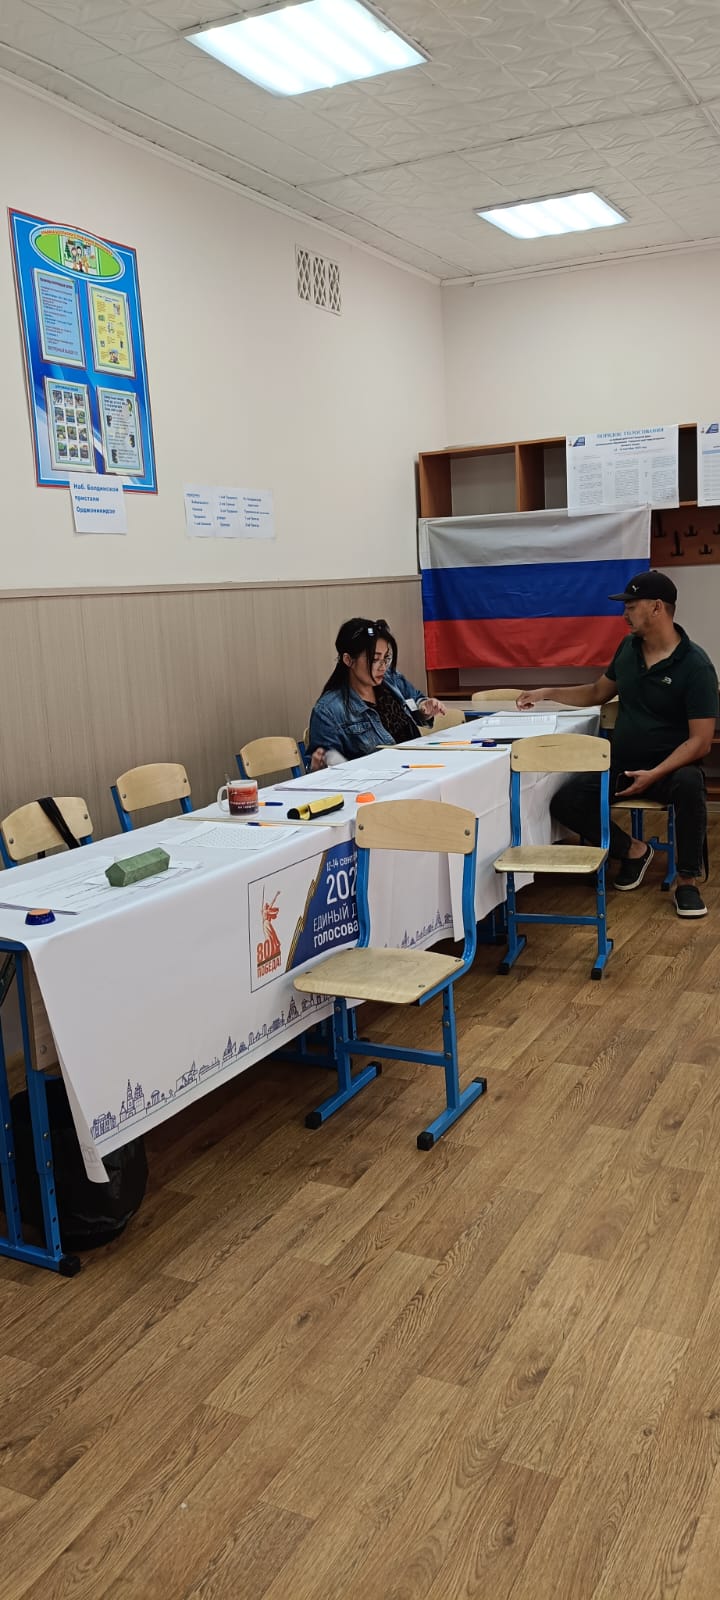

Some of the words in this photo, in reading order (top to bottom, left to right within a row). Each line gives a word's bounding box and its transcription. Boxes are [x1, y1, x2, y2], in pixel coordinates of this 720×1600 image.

[326, 864, 358, 905] 202
[313, 902, 350, 933] ЕДИНЫЙ
[313, 920, 358, 948] голосова
[256, 938, 271, 963] 80
[257, 955, 281, 978] ПОБЕДА!
